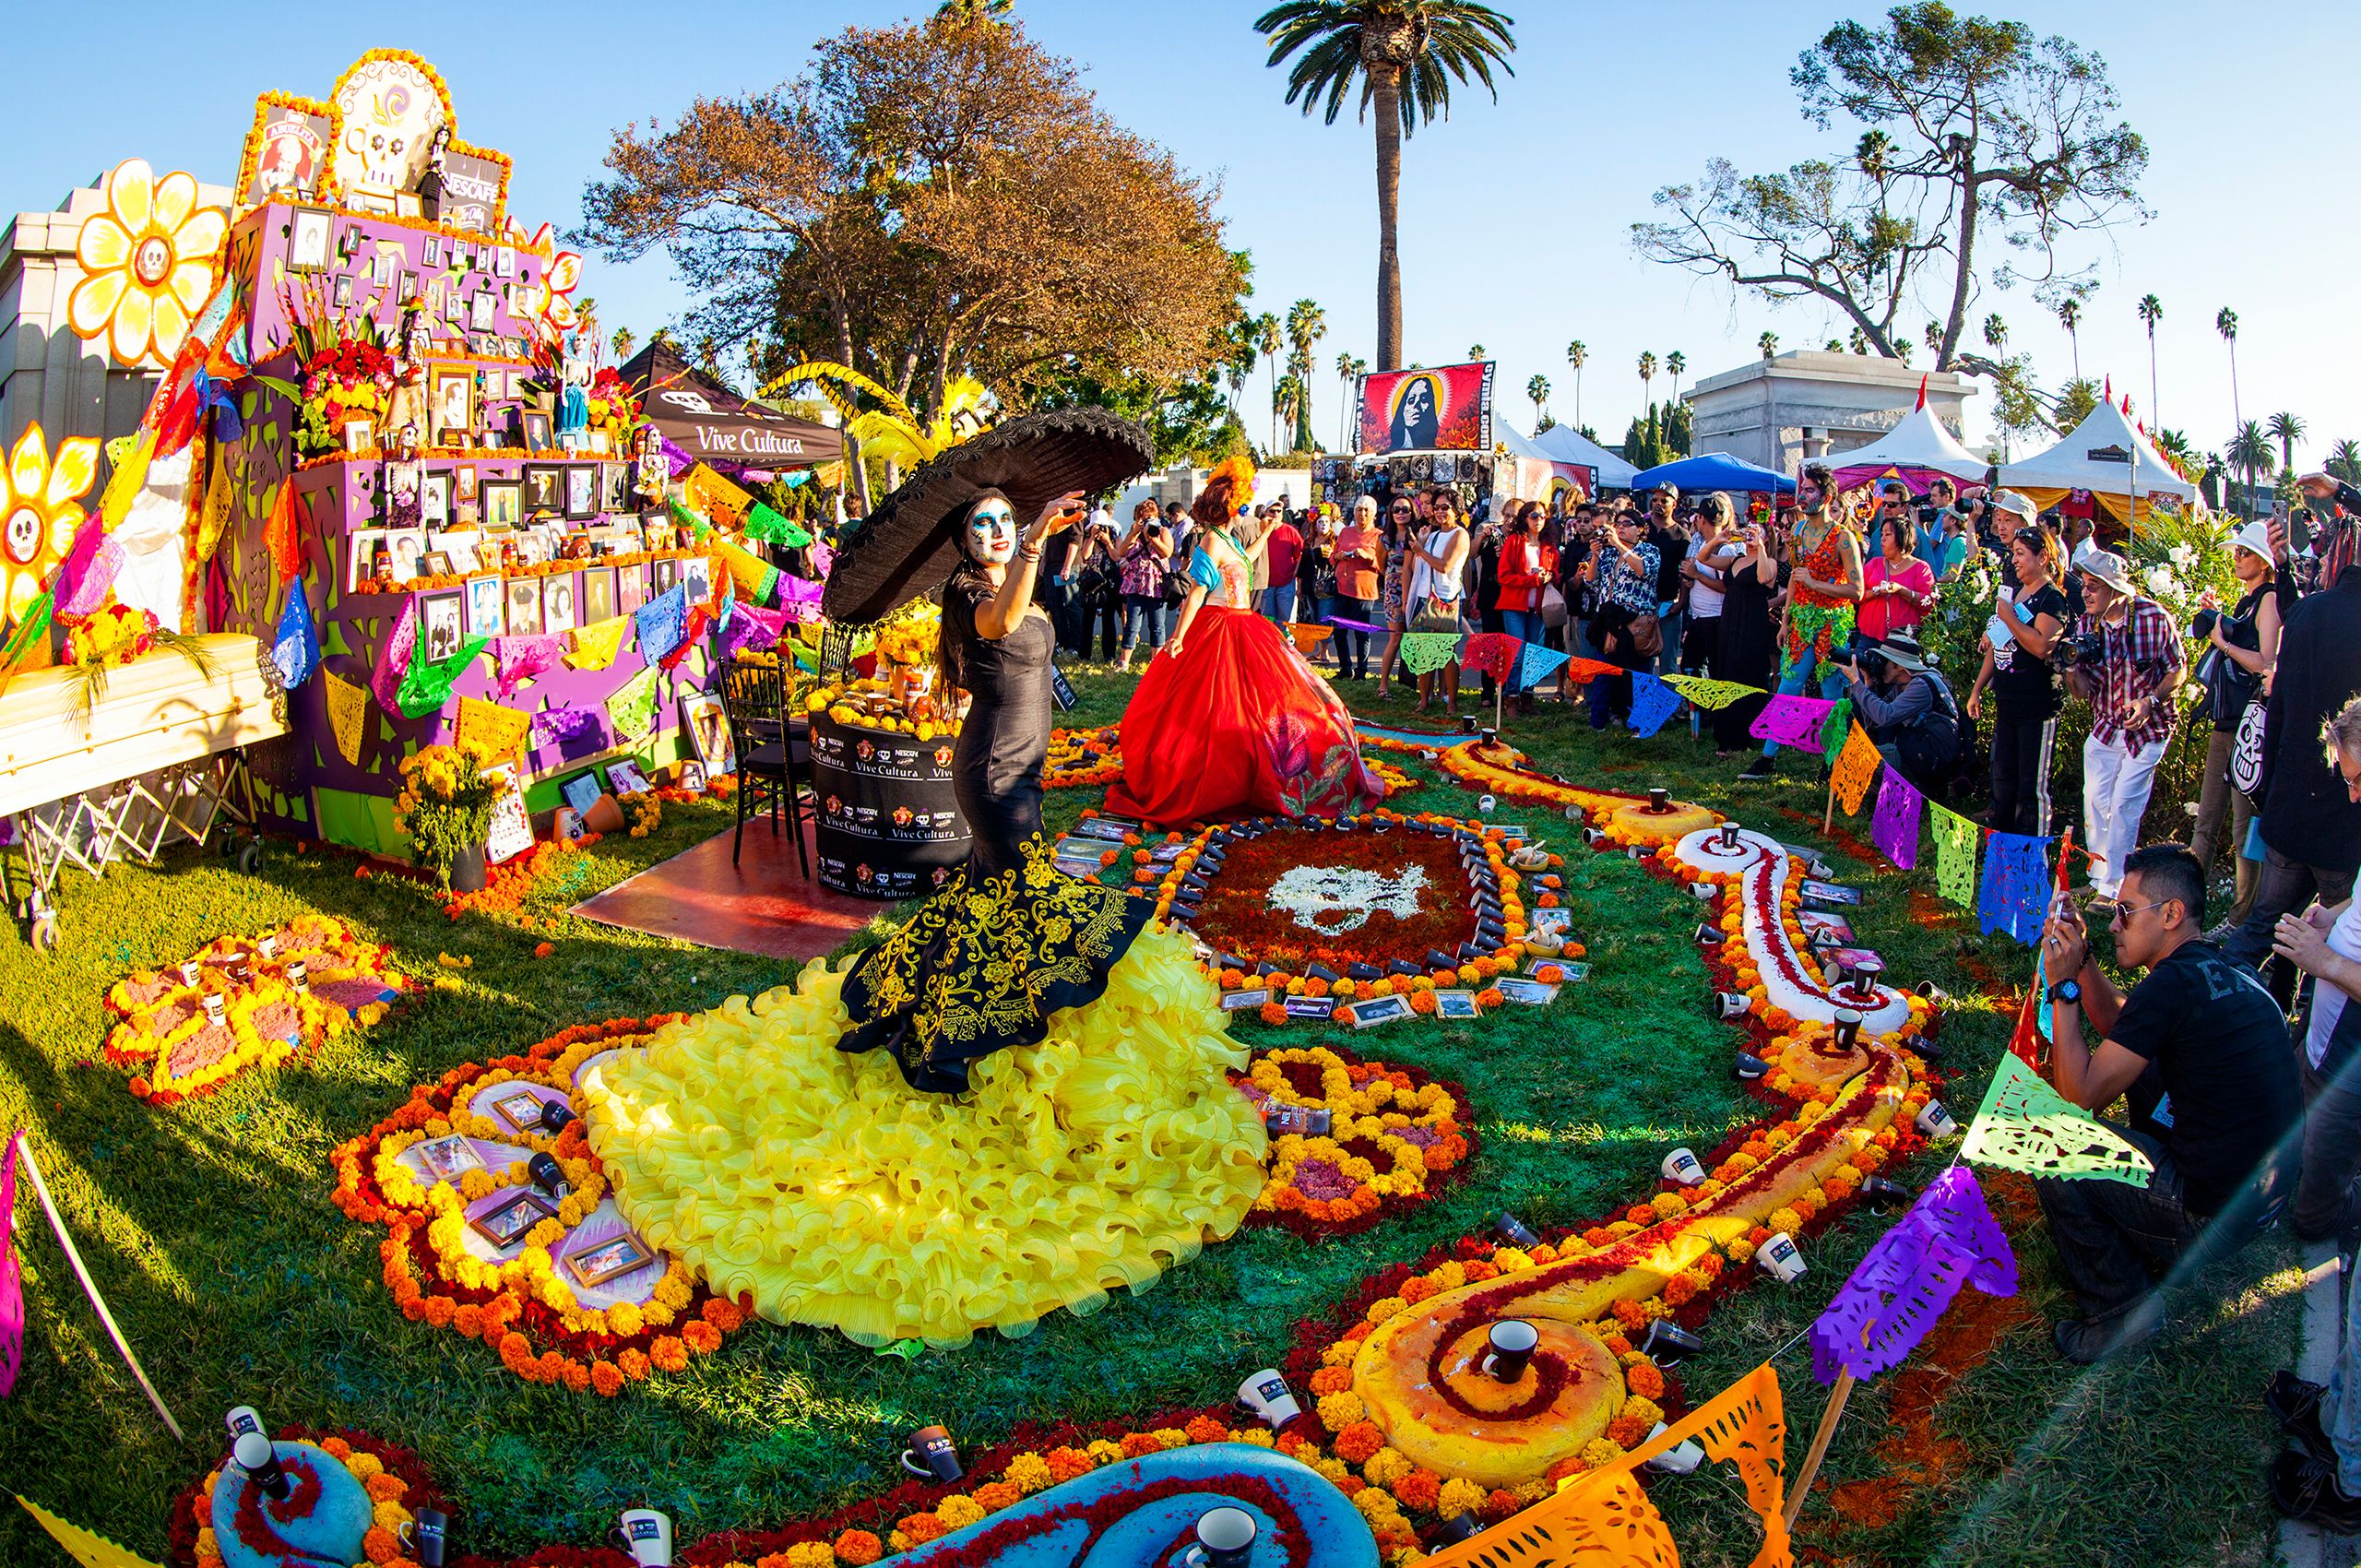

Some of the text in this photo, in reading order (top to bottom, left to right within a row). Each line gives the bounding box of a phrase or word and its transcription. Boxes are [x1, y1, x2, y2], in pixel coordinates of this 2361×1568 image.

[270, 124, 314, 146] ABUELITA
[1480, 363, 1493, 449] cymla.com
[695, 426, 804, 454] Vive Cultura
[819, 752, 845, 767] Cultura
[856, 762, 919, 778] Vive Cultura
[826, 814, 844, 828] Vive
[844, 820, 878, 836] Cultura
[892, 828, 915, 838] Vive
[917, 830, 955, 839] Cultura
[856, 883, 876, 894] Vive
[2154, 1111, 2175, 1128] CRE
